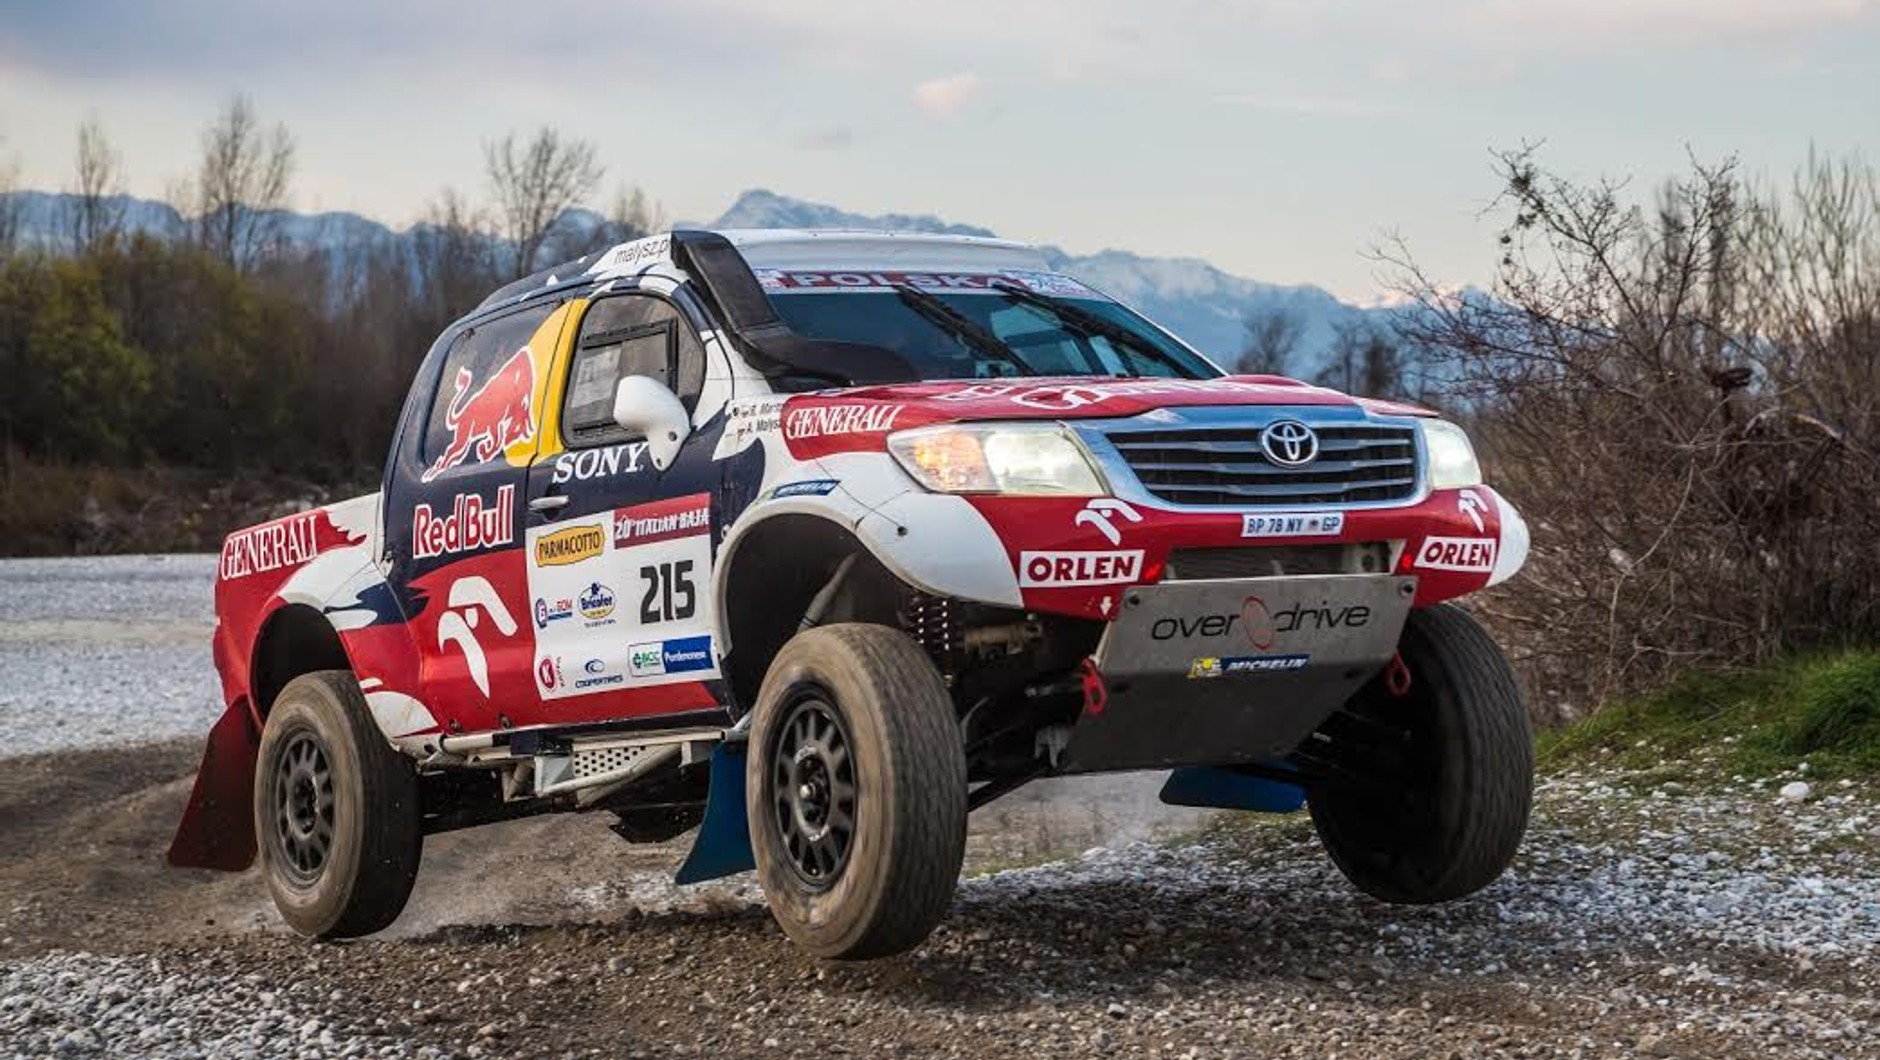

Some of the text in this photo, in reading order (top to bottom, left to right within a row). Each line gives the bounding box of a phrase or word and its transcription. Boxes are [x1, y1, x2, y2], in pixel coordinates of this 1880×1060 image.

[786, 403, 906, 440] GENERALI
[552, 441, 648, 483] SONY
[413, 484, 515, 559] Red Bull
[635, 515, 678, 537] ITALIAN
[679, 507, 711, 529] BAJA
[221, 515, 317, 581] GENERALI
[538, 531, 600, 561] PARMACOTTO
[1424, 542, 1492, 566] ORLEN
[1027, 556, 1135, 582] ORLEN
[639, 560, 695, 625] 215
[1151, 600, 1371, 641] over drive
[1227, 658, 1307, 671] MICHELIN
